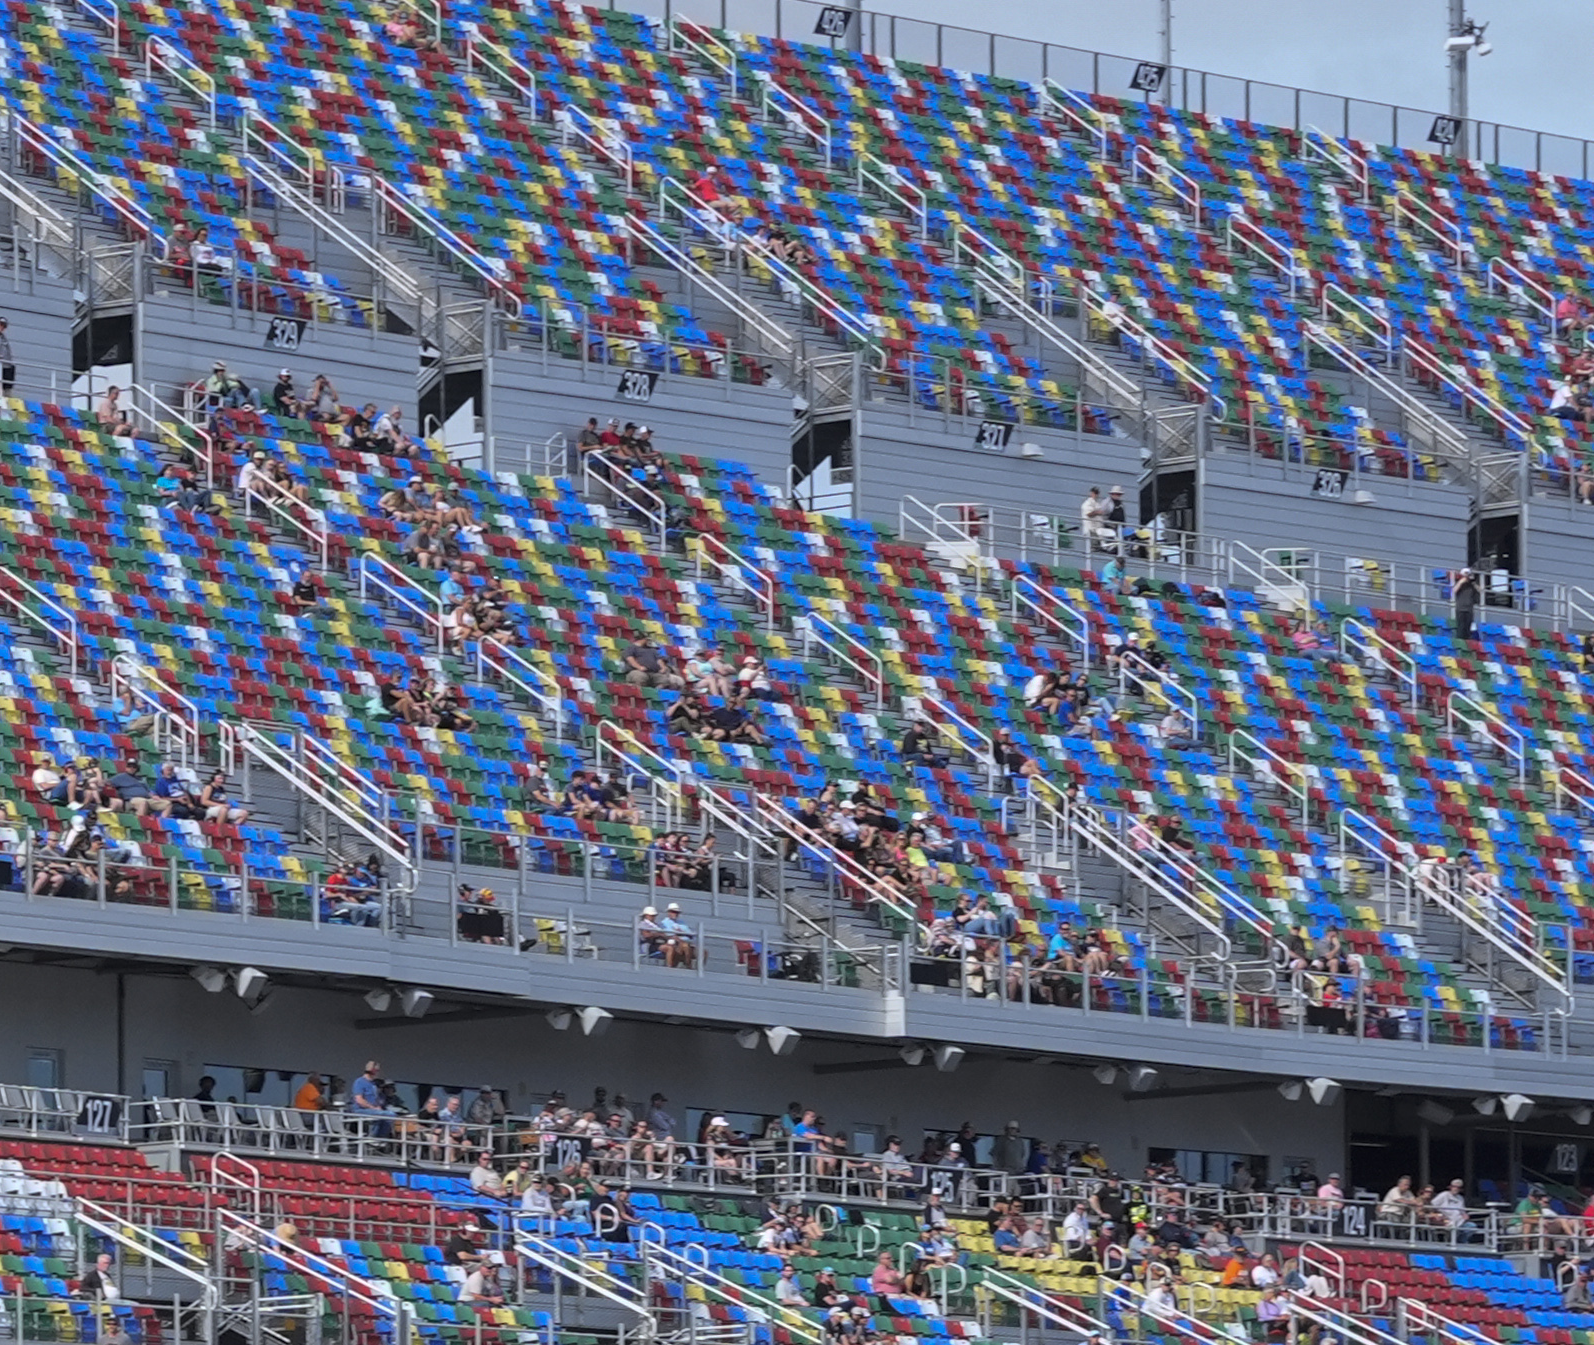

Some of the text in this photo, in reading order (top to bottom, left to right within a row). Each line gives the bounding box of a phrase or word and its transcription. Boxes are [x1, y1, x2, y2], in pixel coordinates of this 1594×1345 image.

[273, 319, 298, 350] 329
[624, 371, 649, 402] 328
[981, 422, 1005, 450] 327
[1319, 471, 1341, 498] 326
[86, 1099, 112, 1133] 127
[1343, 1206, 1365, 1235] 124
